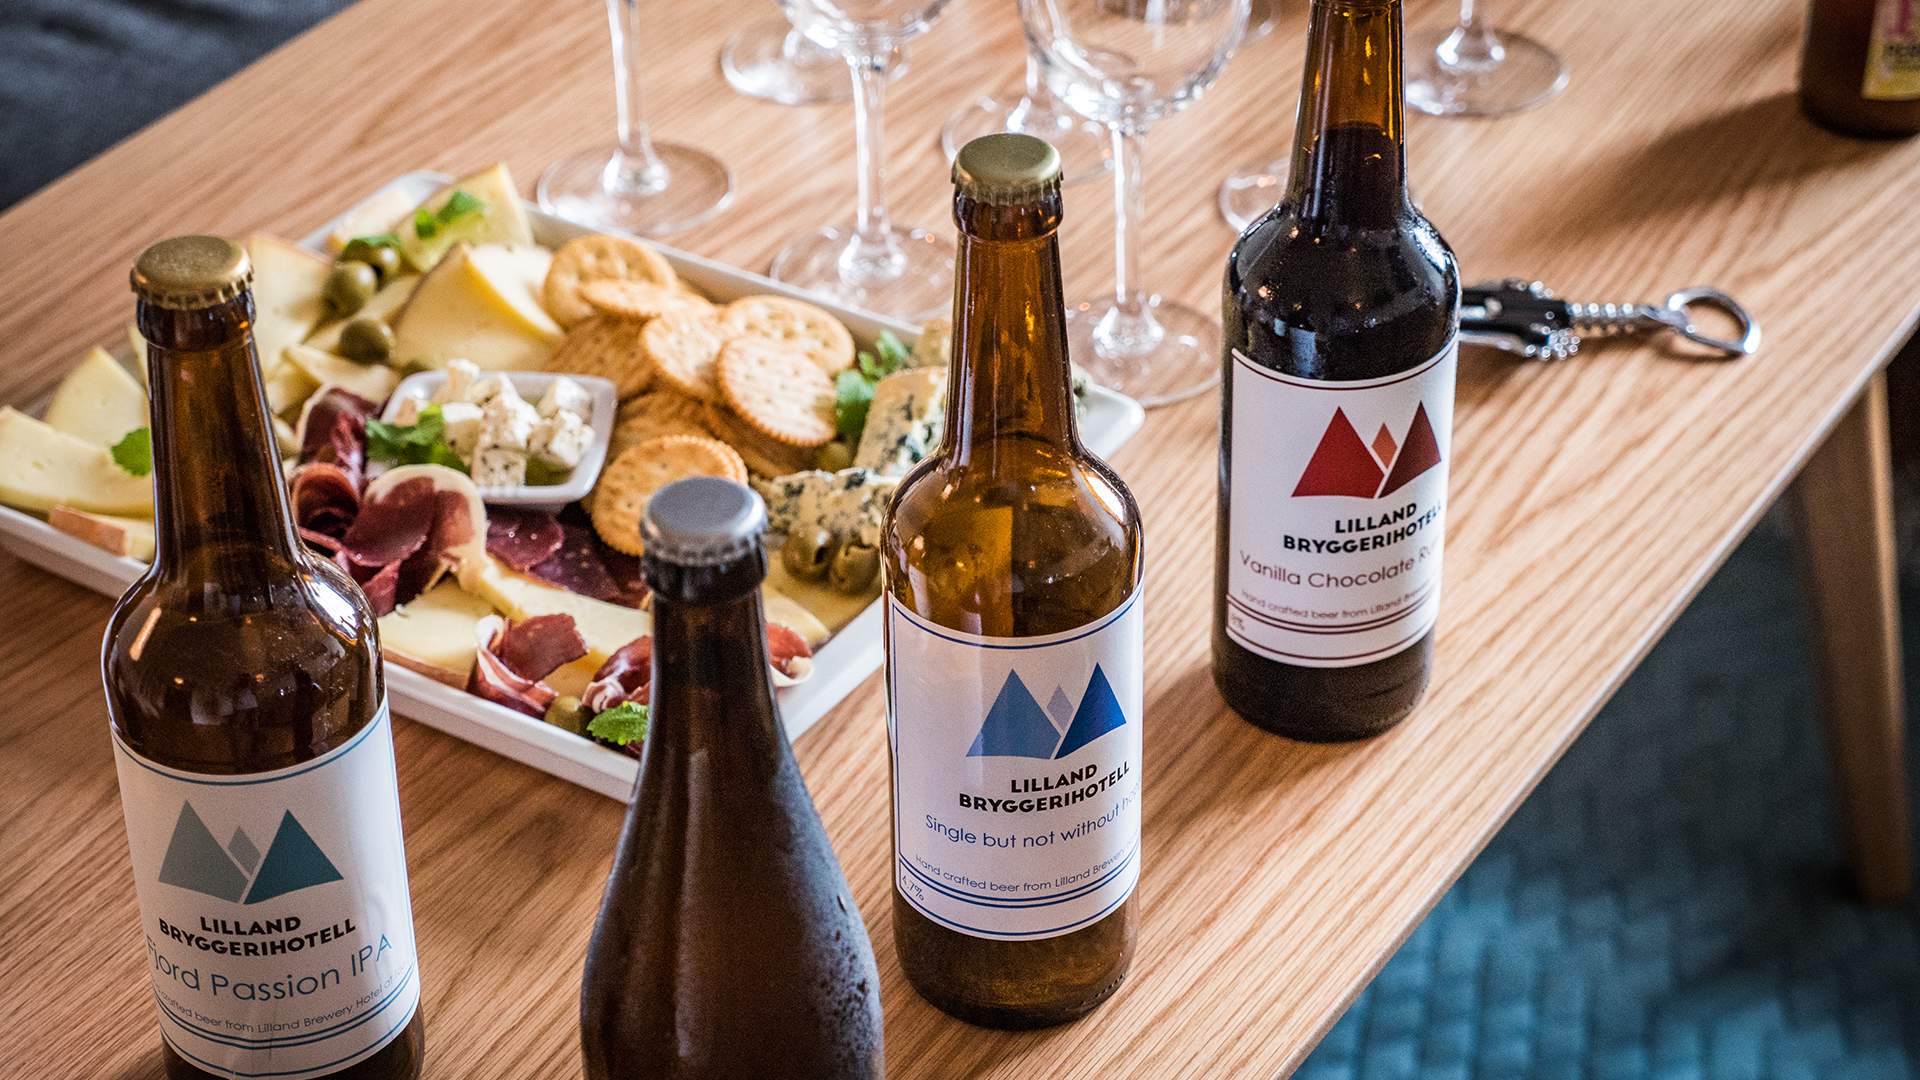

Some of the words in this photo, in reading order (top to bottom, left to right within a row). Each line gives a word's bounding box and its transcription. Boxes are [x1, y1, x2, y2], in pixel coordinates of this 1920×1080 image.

[1335, 503, 1417, 533] LILLAND
[1240, 550, 1301, 585] Vanilla
[1308, 557, 1415, 588] Chocolate
[1311, 610, 1338, 618] beer
[959, 761, 1130, 813] BRYGGERIHOTELL
[1011, 764, 1098, 793] LILLAND
[925, 814, 976, 844] Single
[983, 832, 1016, 848] but
[1023, 831, 1056, 848] not
[1060, 803, 1120, 842] without
[943, 872, 986, 890] crafted
[990, 881, 1019, 892] beer
[1023, 881, 1051, 892] from
[1055, 868, 1091, 888] Lilland
[159, 918, 357, 957] BRYGGERIHOTELL
[200, 915, 301, 937] LILLAND
[146, 934, 200, 991] Fjord
[211, 968, 340, 1001] Passion
[351, 933, 392, 977] IPA
[195, 1011, 222, 1026] beer
[225, 1020, 254, 1033] from
[258, 1020, 300, 1034] Lilland
[304, 1004, 353, 1028] Brewery
[356, 986, 383, 1009] Hotel
